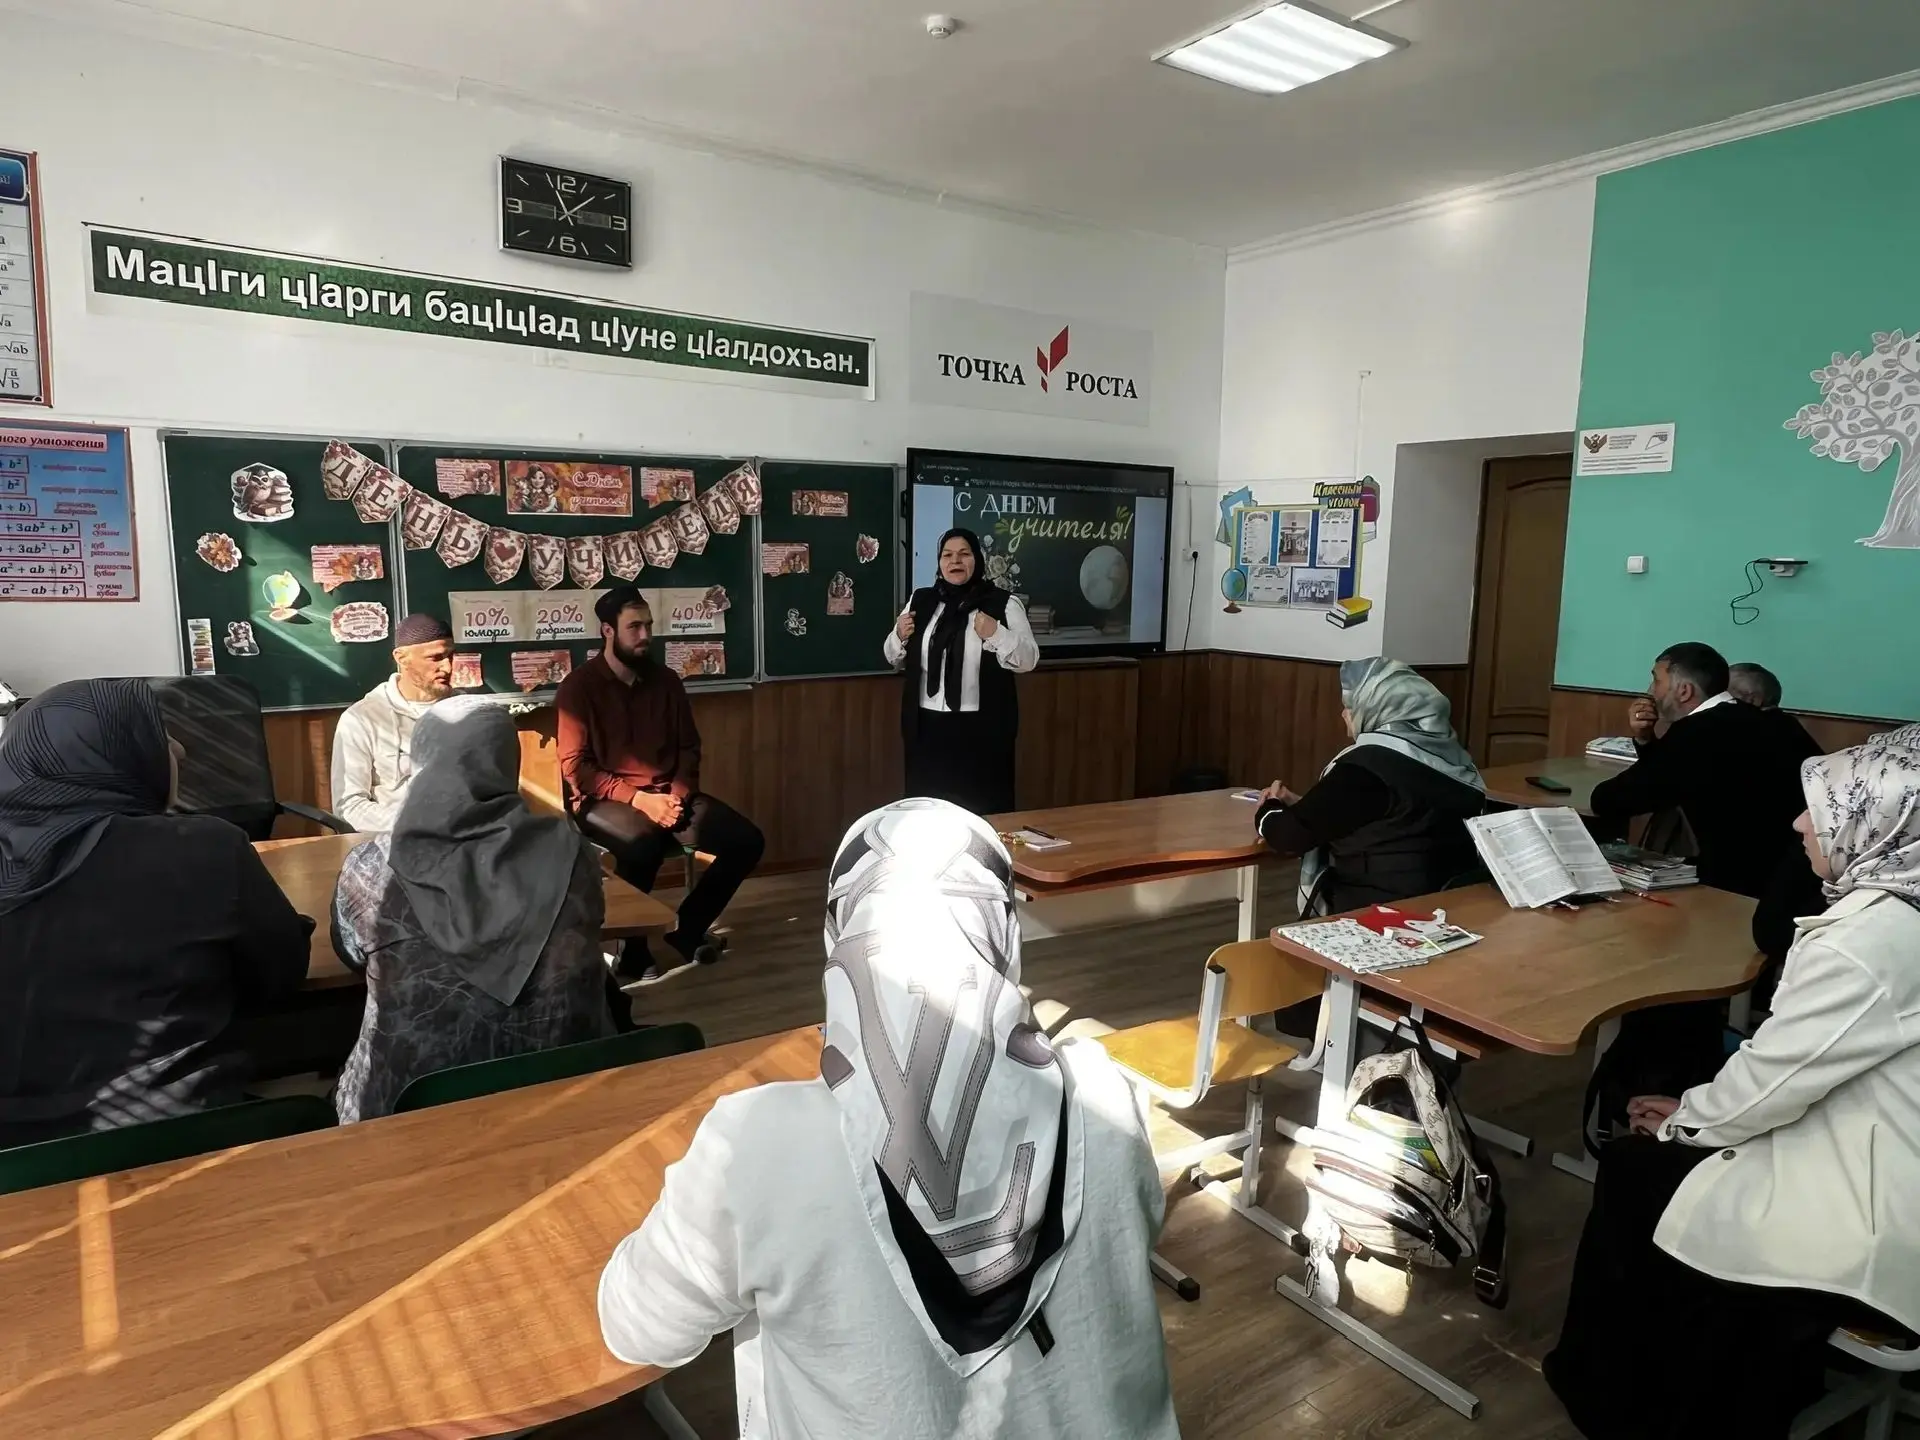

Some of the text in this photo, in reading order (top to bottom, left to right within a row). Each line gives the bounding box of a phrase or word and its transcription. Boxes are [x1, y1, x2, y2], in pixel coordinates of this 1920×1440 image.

[557, 174, 577, 194] 12
[612, 215, 627, 231] 3
[559, 236, 577, 254] 6
[938, 353, 1026, 386] ТОЧКА
[1066, 371, 1138, 399] РОСТА
[30, 437, 104, 448] умножения
[954, 492, 1056, 519] С ДНЕМ
[1008, 512, 1134, 553] учителя!
[465, 607, 510, 627] 10%
[537, 604, 583, 624] 20%
[672, 602, 713, 620] 40%
[464, 628, 510, 642] юмора
[536, 623, 585, 640] доброты
